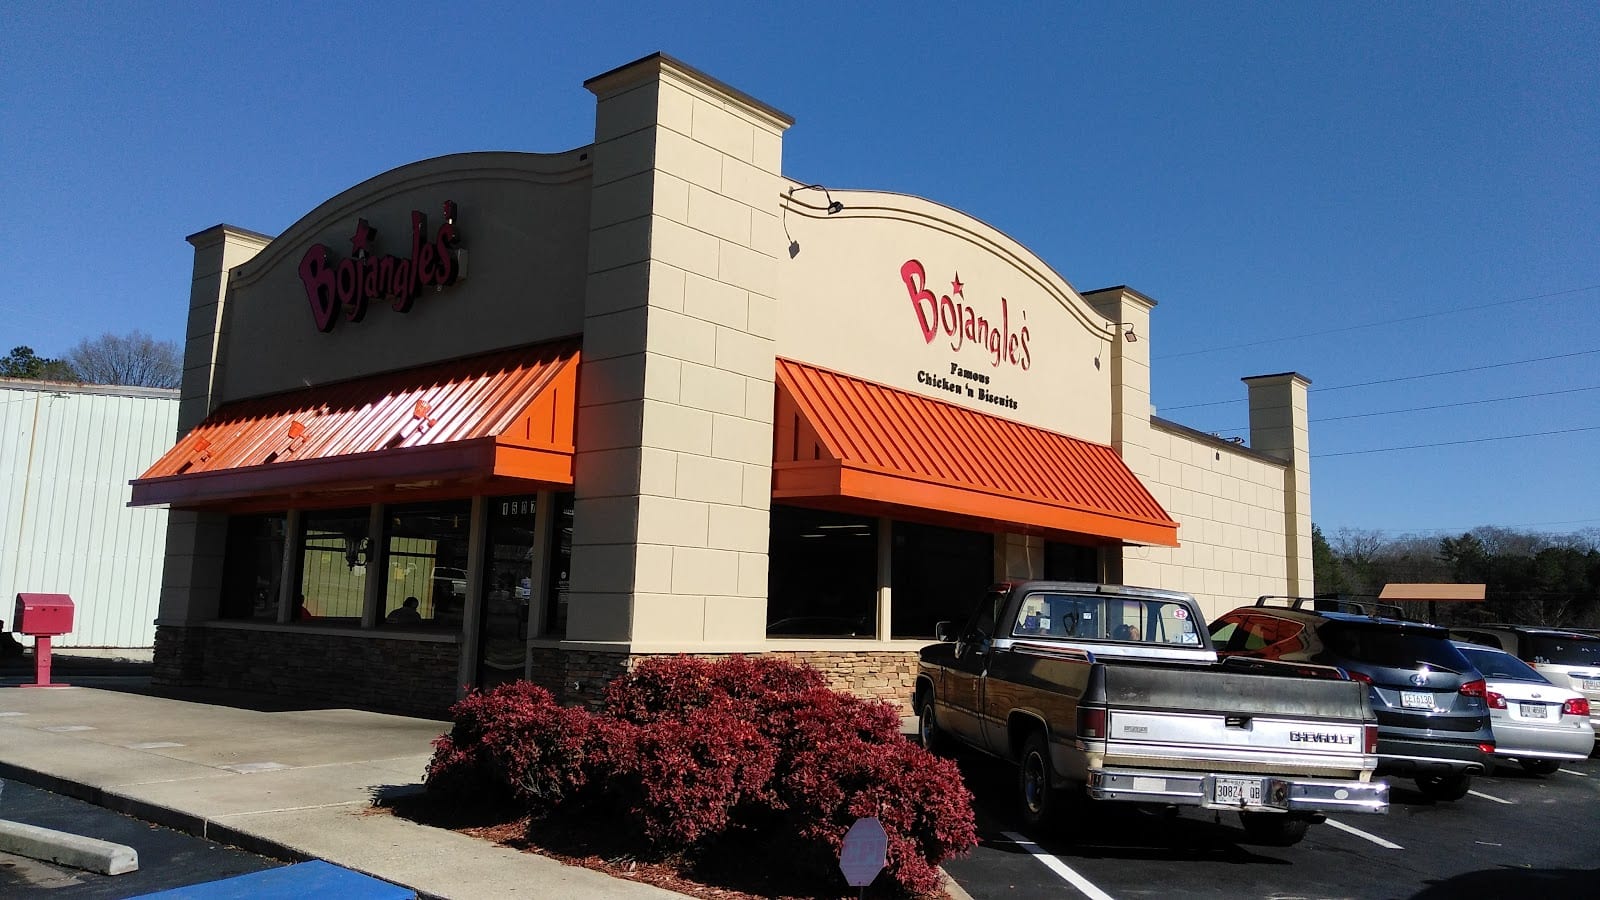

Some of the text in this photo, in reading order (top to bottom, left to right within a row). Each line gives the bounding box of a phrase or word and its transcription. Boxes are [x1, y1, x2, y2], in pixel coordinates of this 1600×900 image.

[950, 362, 990, 385] Famous
[917, 370, 962, 395] Chicken
[978, 388, 1018, 410] Biscuits
[1289, 731, 1354, 745] CHEVROLET
